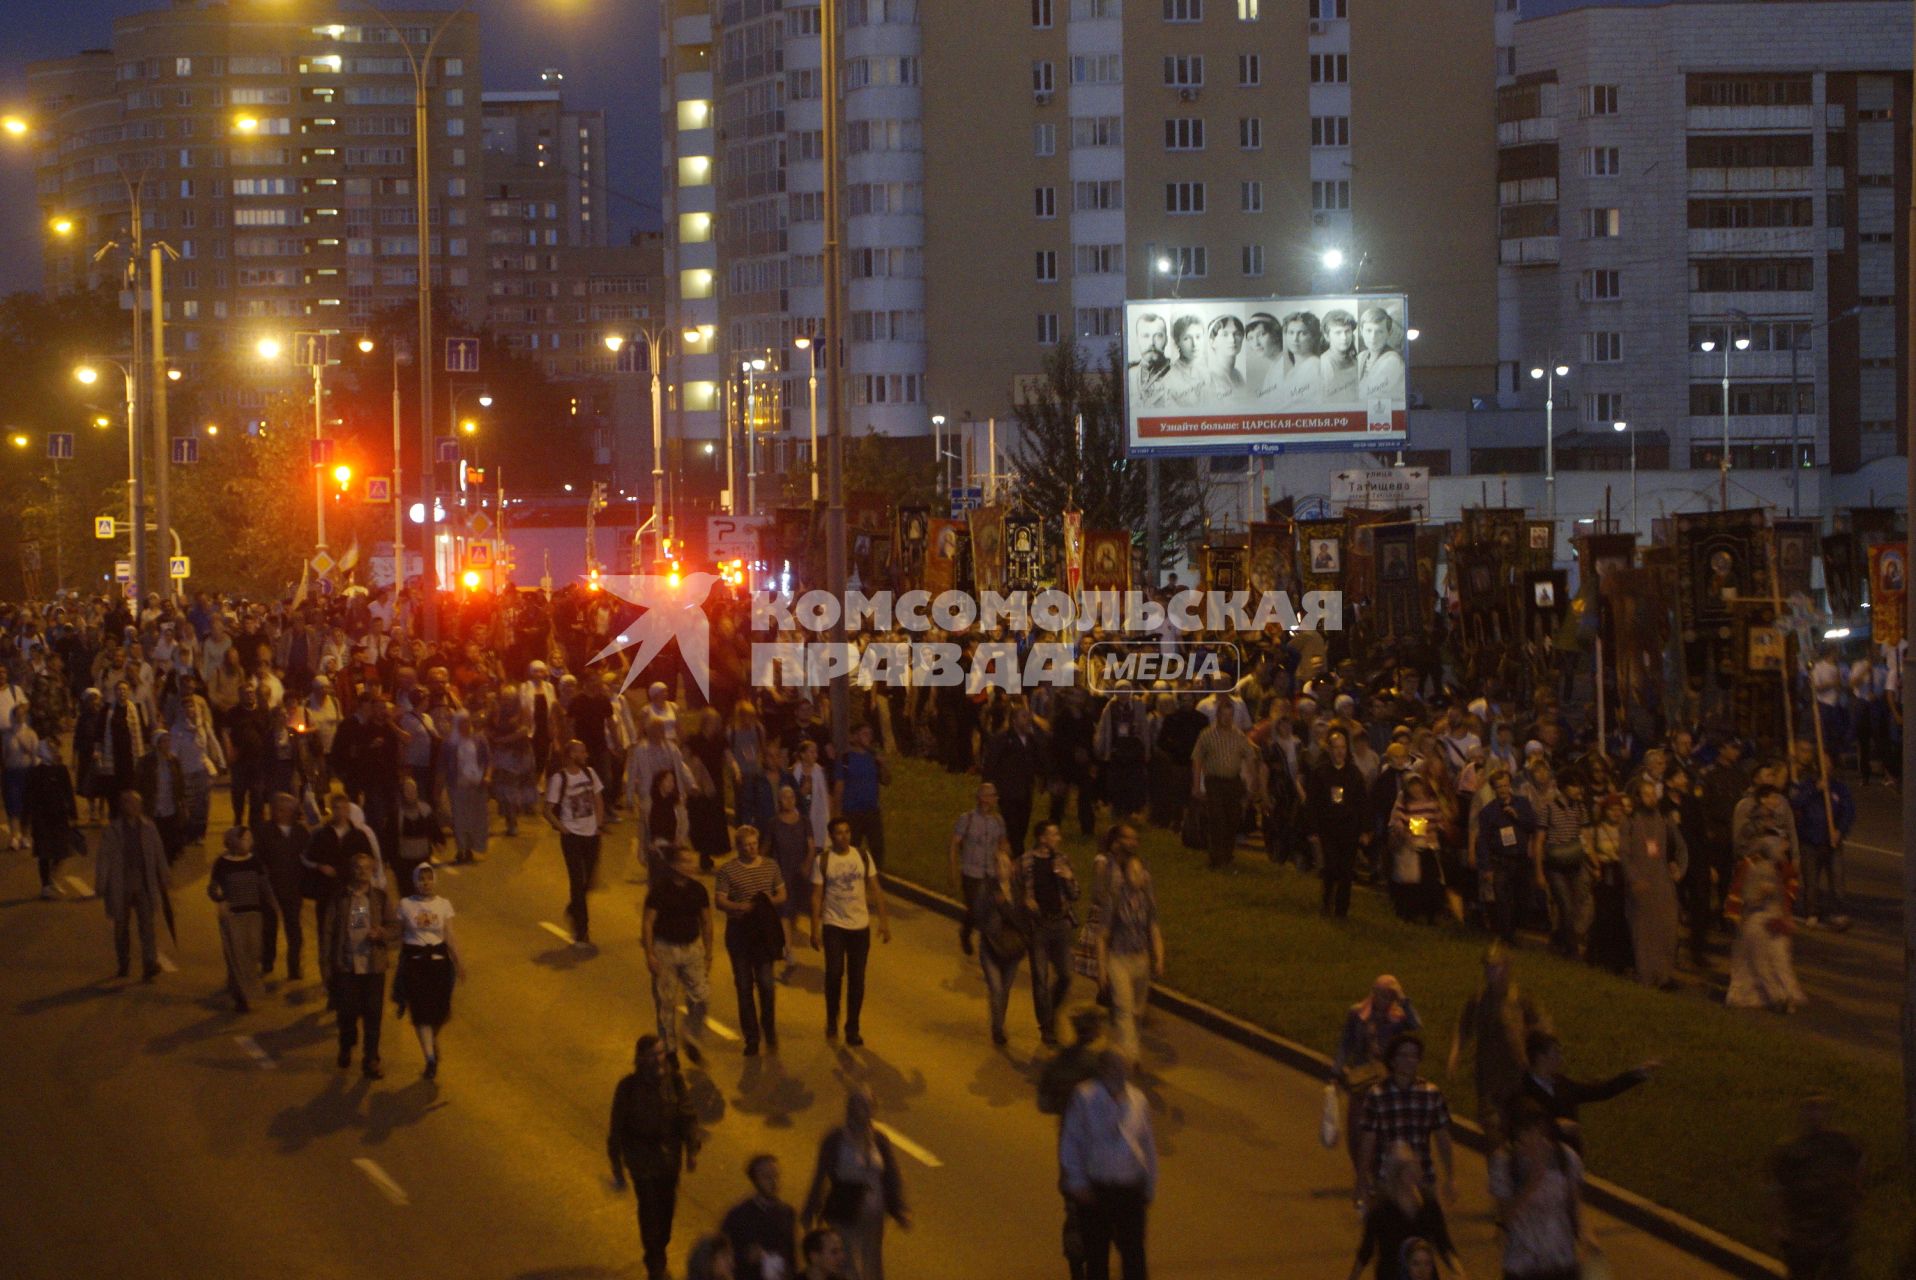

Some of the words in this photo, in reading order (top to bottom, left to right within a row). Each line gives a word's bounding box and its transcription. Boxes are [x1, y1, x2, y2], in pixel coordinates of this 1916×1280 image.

[1159, 421, 1199, 433] Узнайте
[1200, 419, 1240, 431] больше:
[1242, 417, 1349, 430] ЦАРСКАЯ-СЕМЬЯ.РФ
[1366, 471, 1393, 479] улица
[1349, 482, 1410, 492] Татищева
